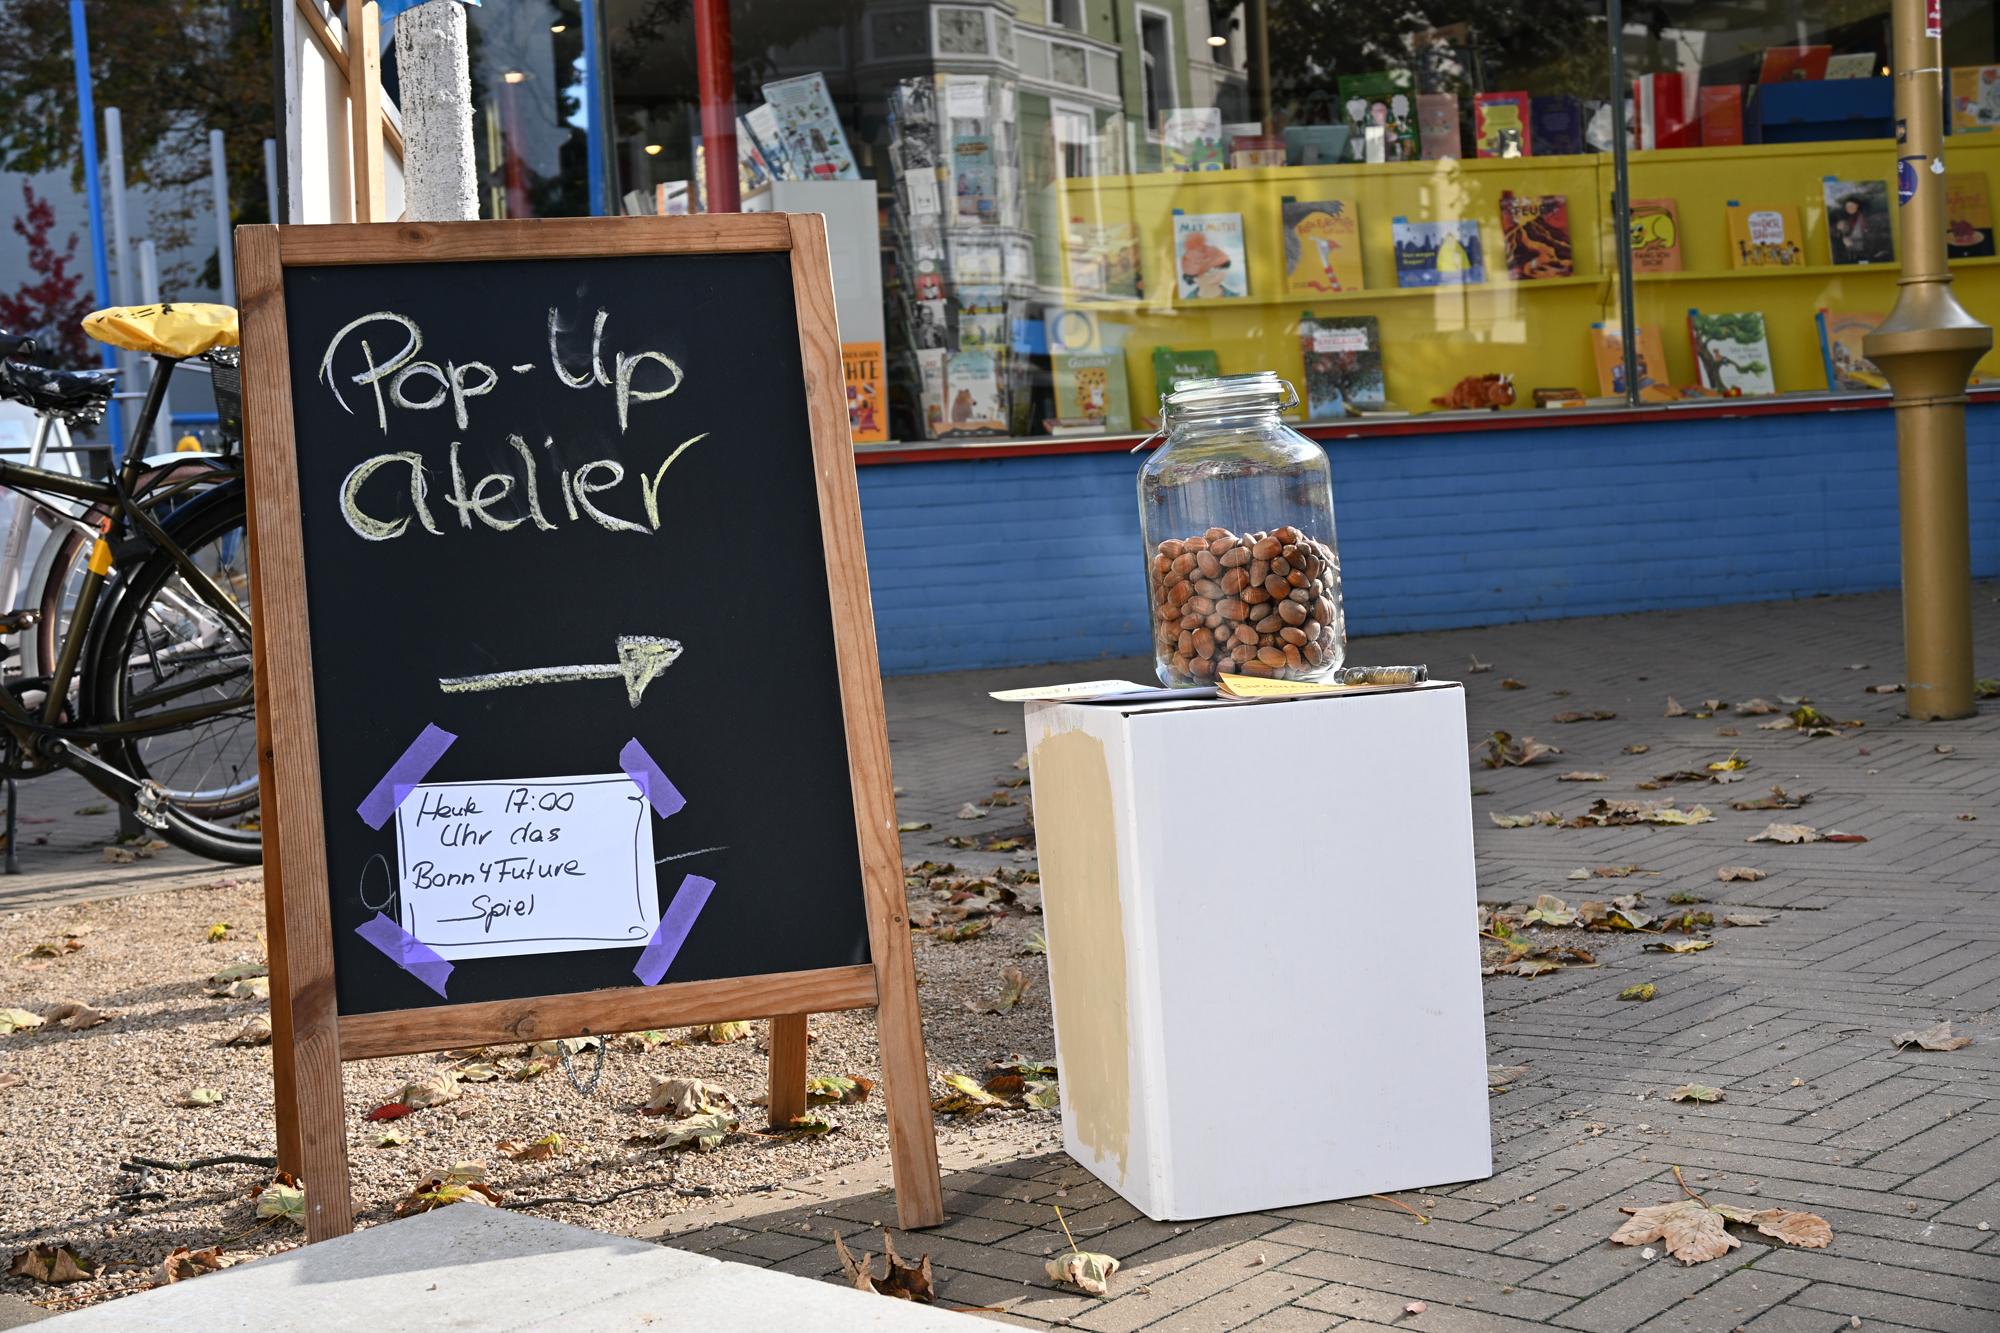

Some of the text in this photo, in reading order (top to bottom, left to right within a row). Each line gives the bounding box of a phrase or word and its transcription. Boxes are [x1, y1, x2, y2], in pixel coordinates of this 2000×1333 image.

[319, 306, 684, 435] Pop-Up
[417, 788, 574, 827] Heute 17:00
[440, 822, 561, 848] Uhr das
[438, 894, 535, 933] Spiel
